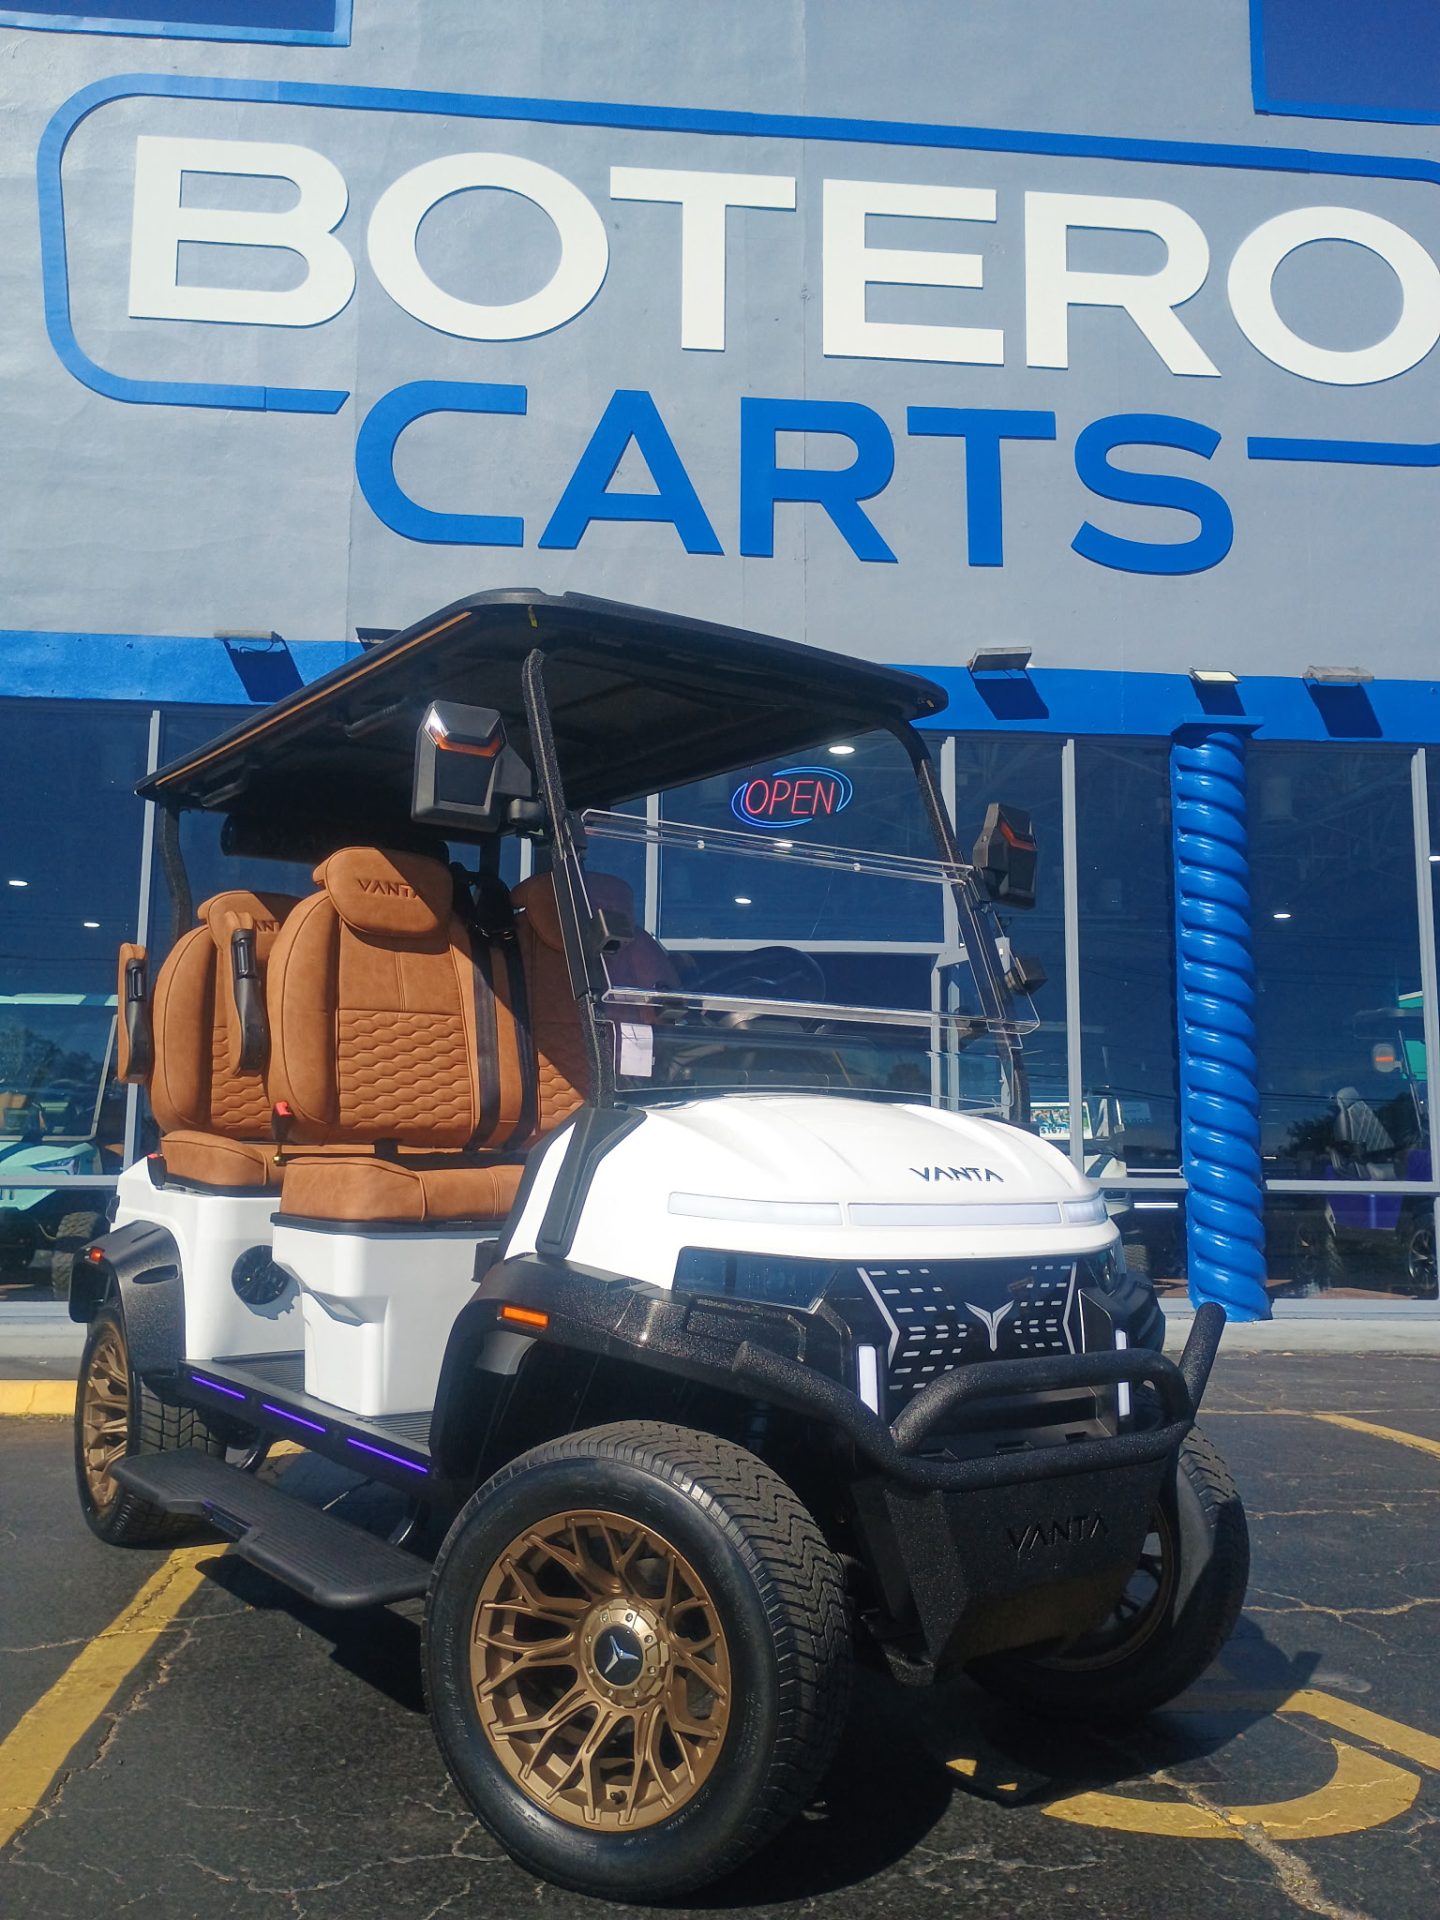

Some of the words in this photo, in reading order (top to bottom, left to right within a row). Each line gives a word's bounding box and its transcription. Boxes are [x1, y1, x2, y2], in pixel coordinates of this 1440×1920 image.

[128, 135, 1440, 385] BOTERO
[355, 380, 1234, 576] CARTS
[745, 779, 835, 815] OPEN
[908, 1166, 1005, 1183] VANTA
[1004, 1515, 1108, 1554] VANTA
